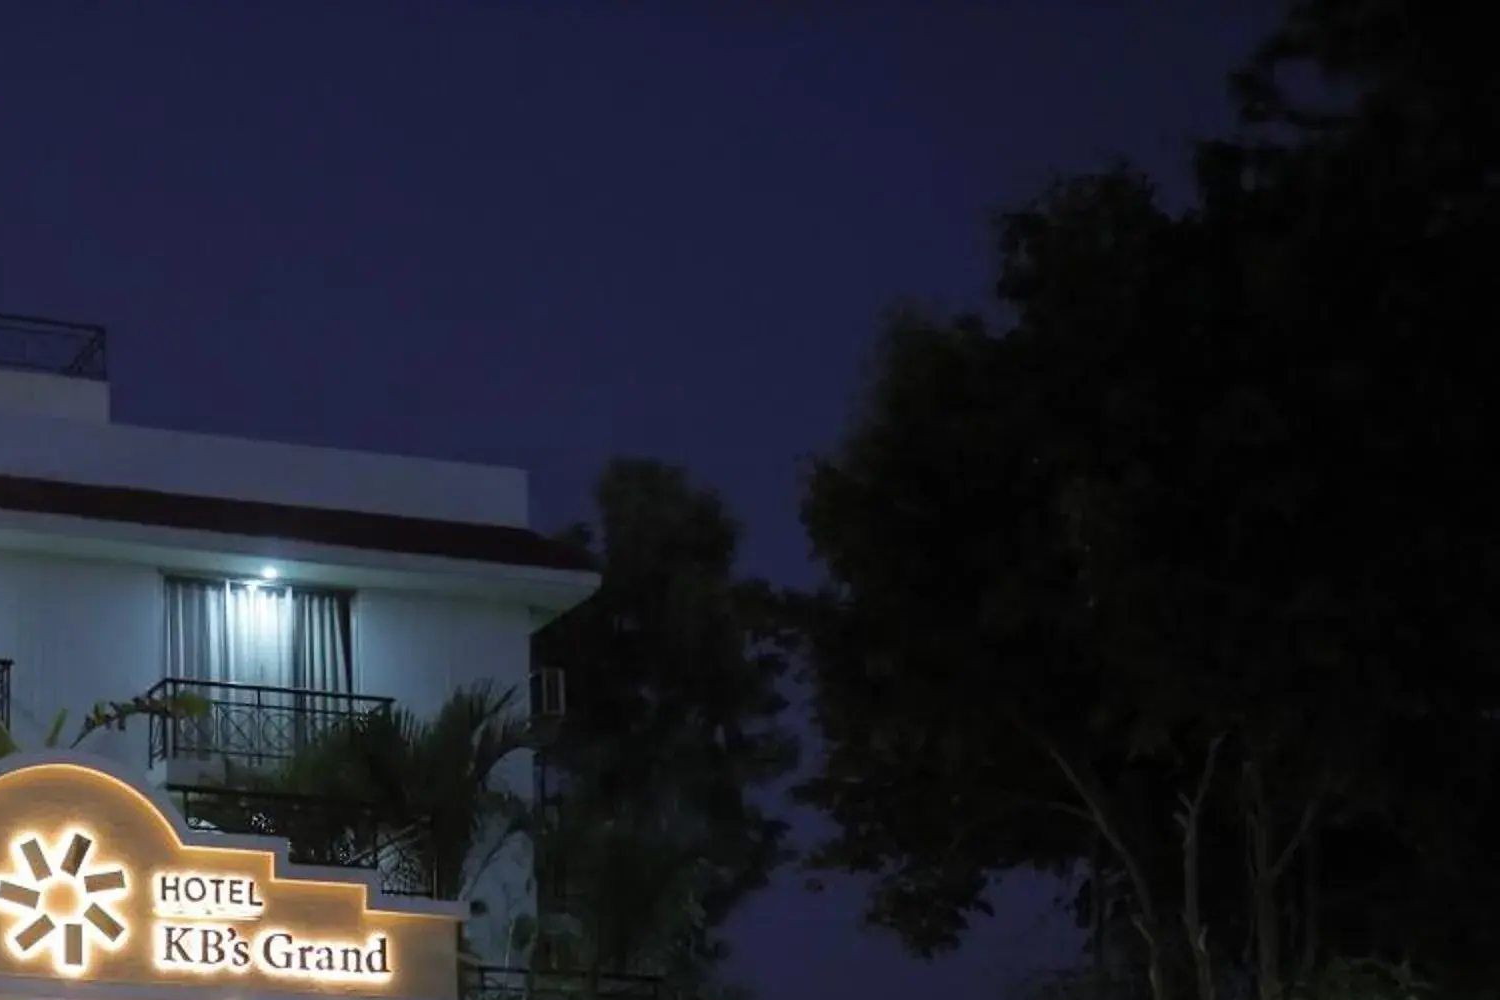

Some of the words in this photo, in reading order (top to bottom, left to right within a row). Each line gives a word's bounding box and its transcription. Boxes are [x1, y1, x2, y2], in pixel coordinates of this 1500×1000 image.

[159, 876, 264, 907] HOTEL
[163, 925, 251, 967] KB's
[262, 932, 392, 974] Grand
